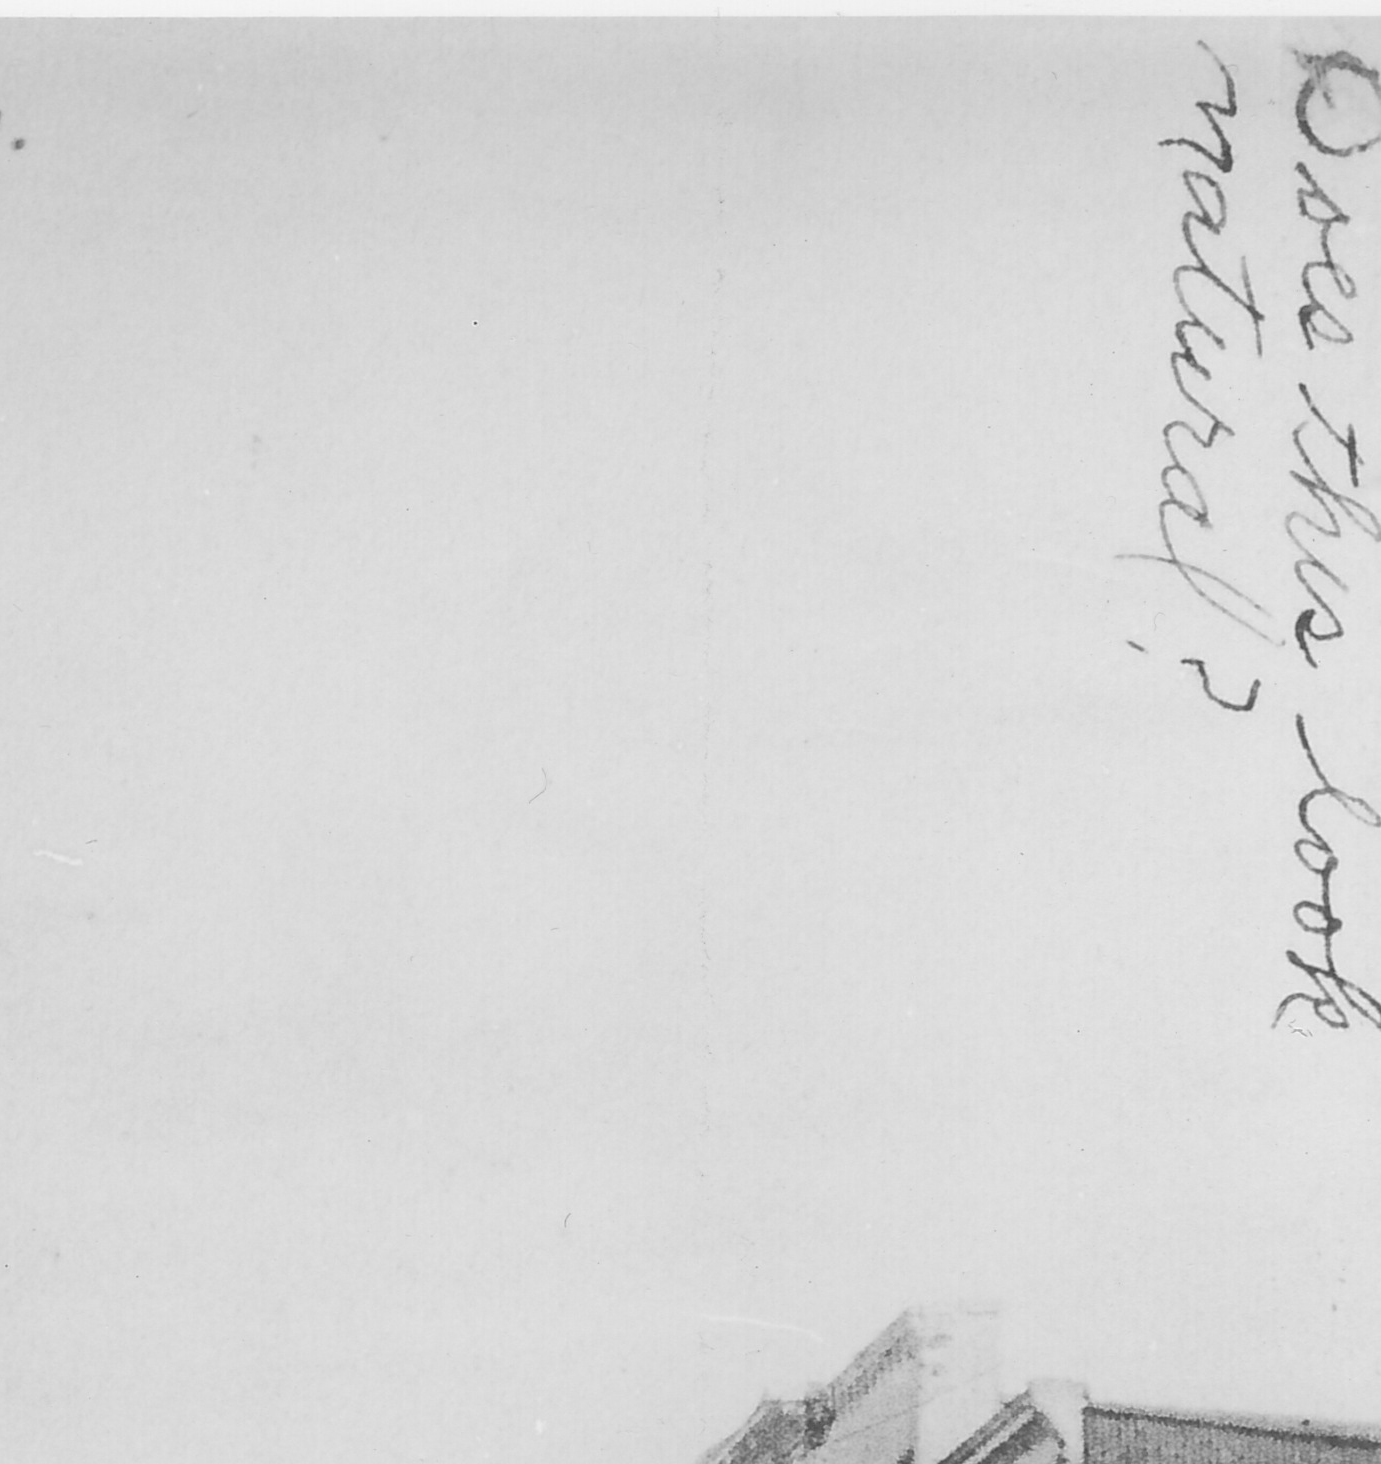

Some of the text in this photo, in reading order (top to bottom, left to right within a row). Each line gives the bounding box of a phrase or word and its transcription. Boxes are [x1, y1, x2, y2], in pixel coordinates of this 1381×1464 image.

[1271, 48, 1381, 1032] Does this look
